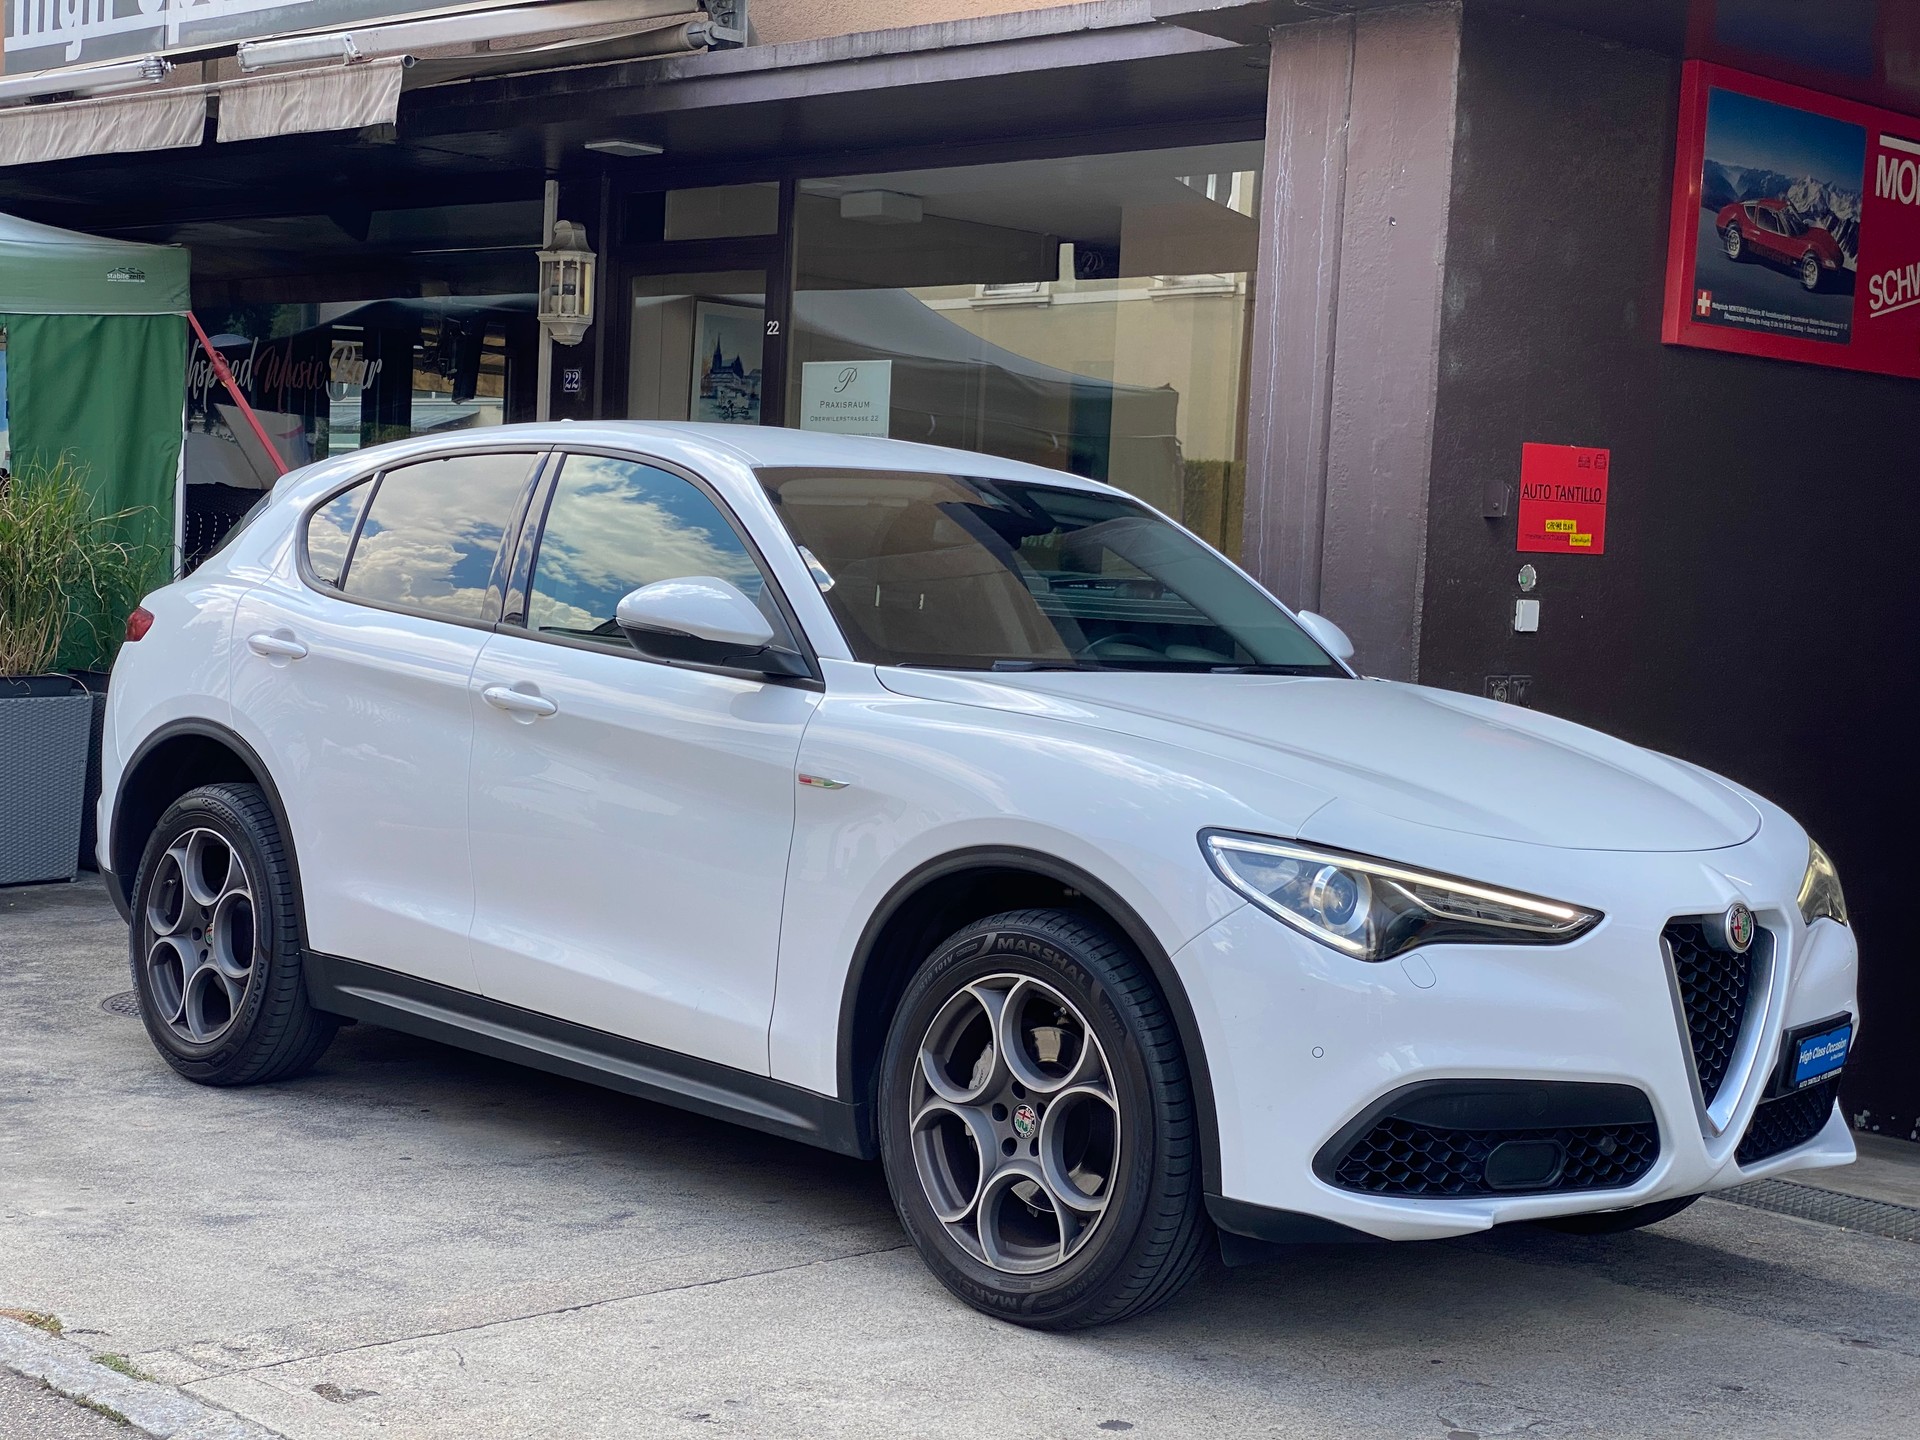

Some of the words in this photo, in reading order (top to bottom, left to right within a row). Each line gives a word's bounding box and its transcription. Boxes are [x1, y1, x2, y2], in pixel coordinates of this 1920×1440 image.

[767, 320, 779, 335] 22
[325, 343, 382, 401] Bar
[565, 371, 579, 389] 22
[819, 400, 870, 409] PRAXISRAUM
[1522, 483, 1552, 499] AUTO
[1555, 485, 1602, 502] TANTILLO
[934, 953, 953, 974] 101V
[997, 938, 1088, 990] MARSHAL
